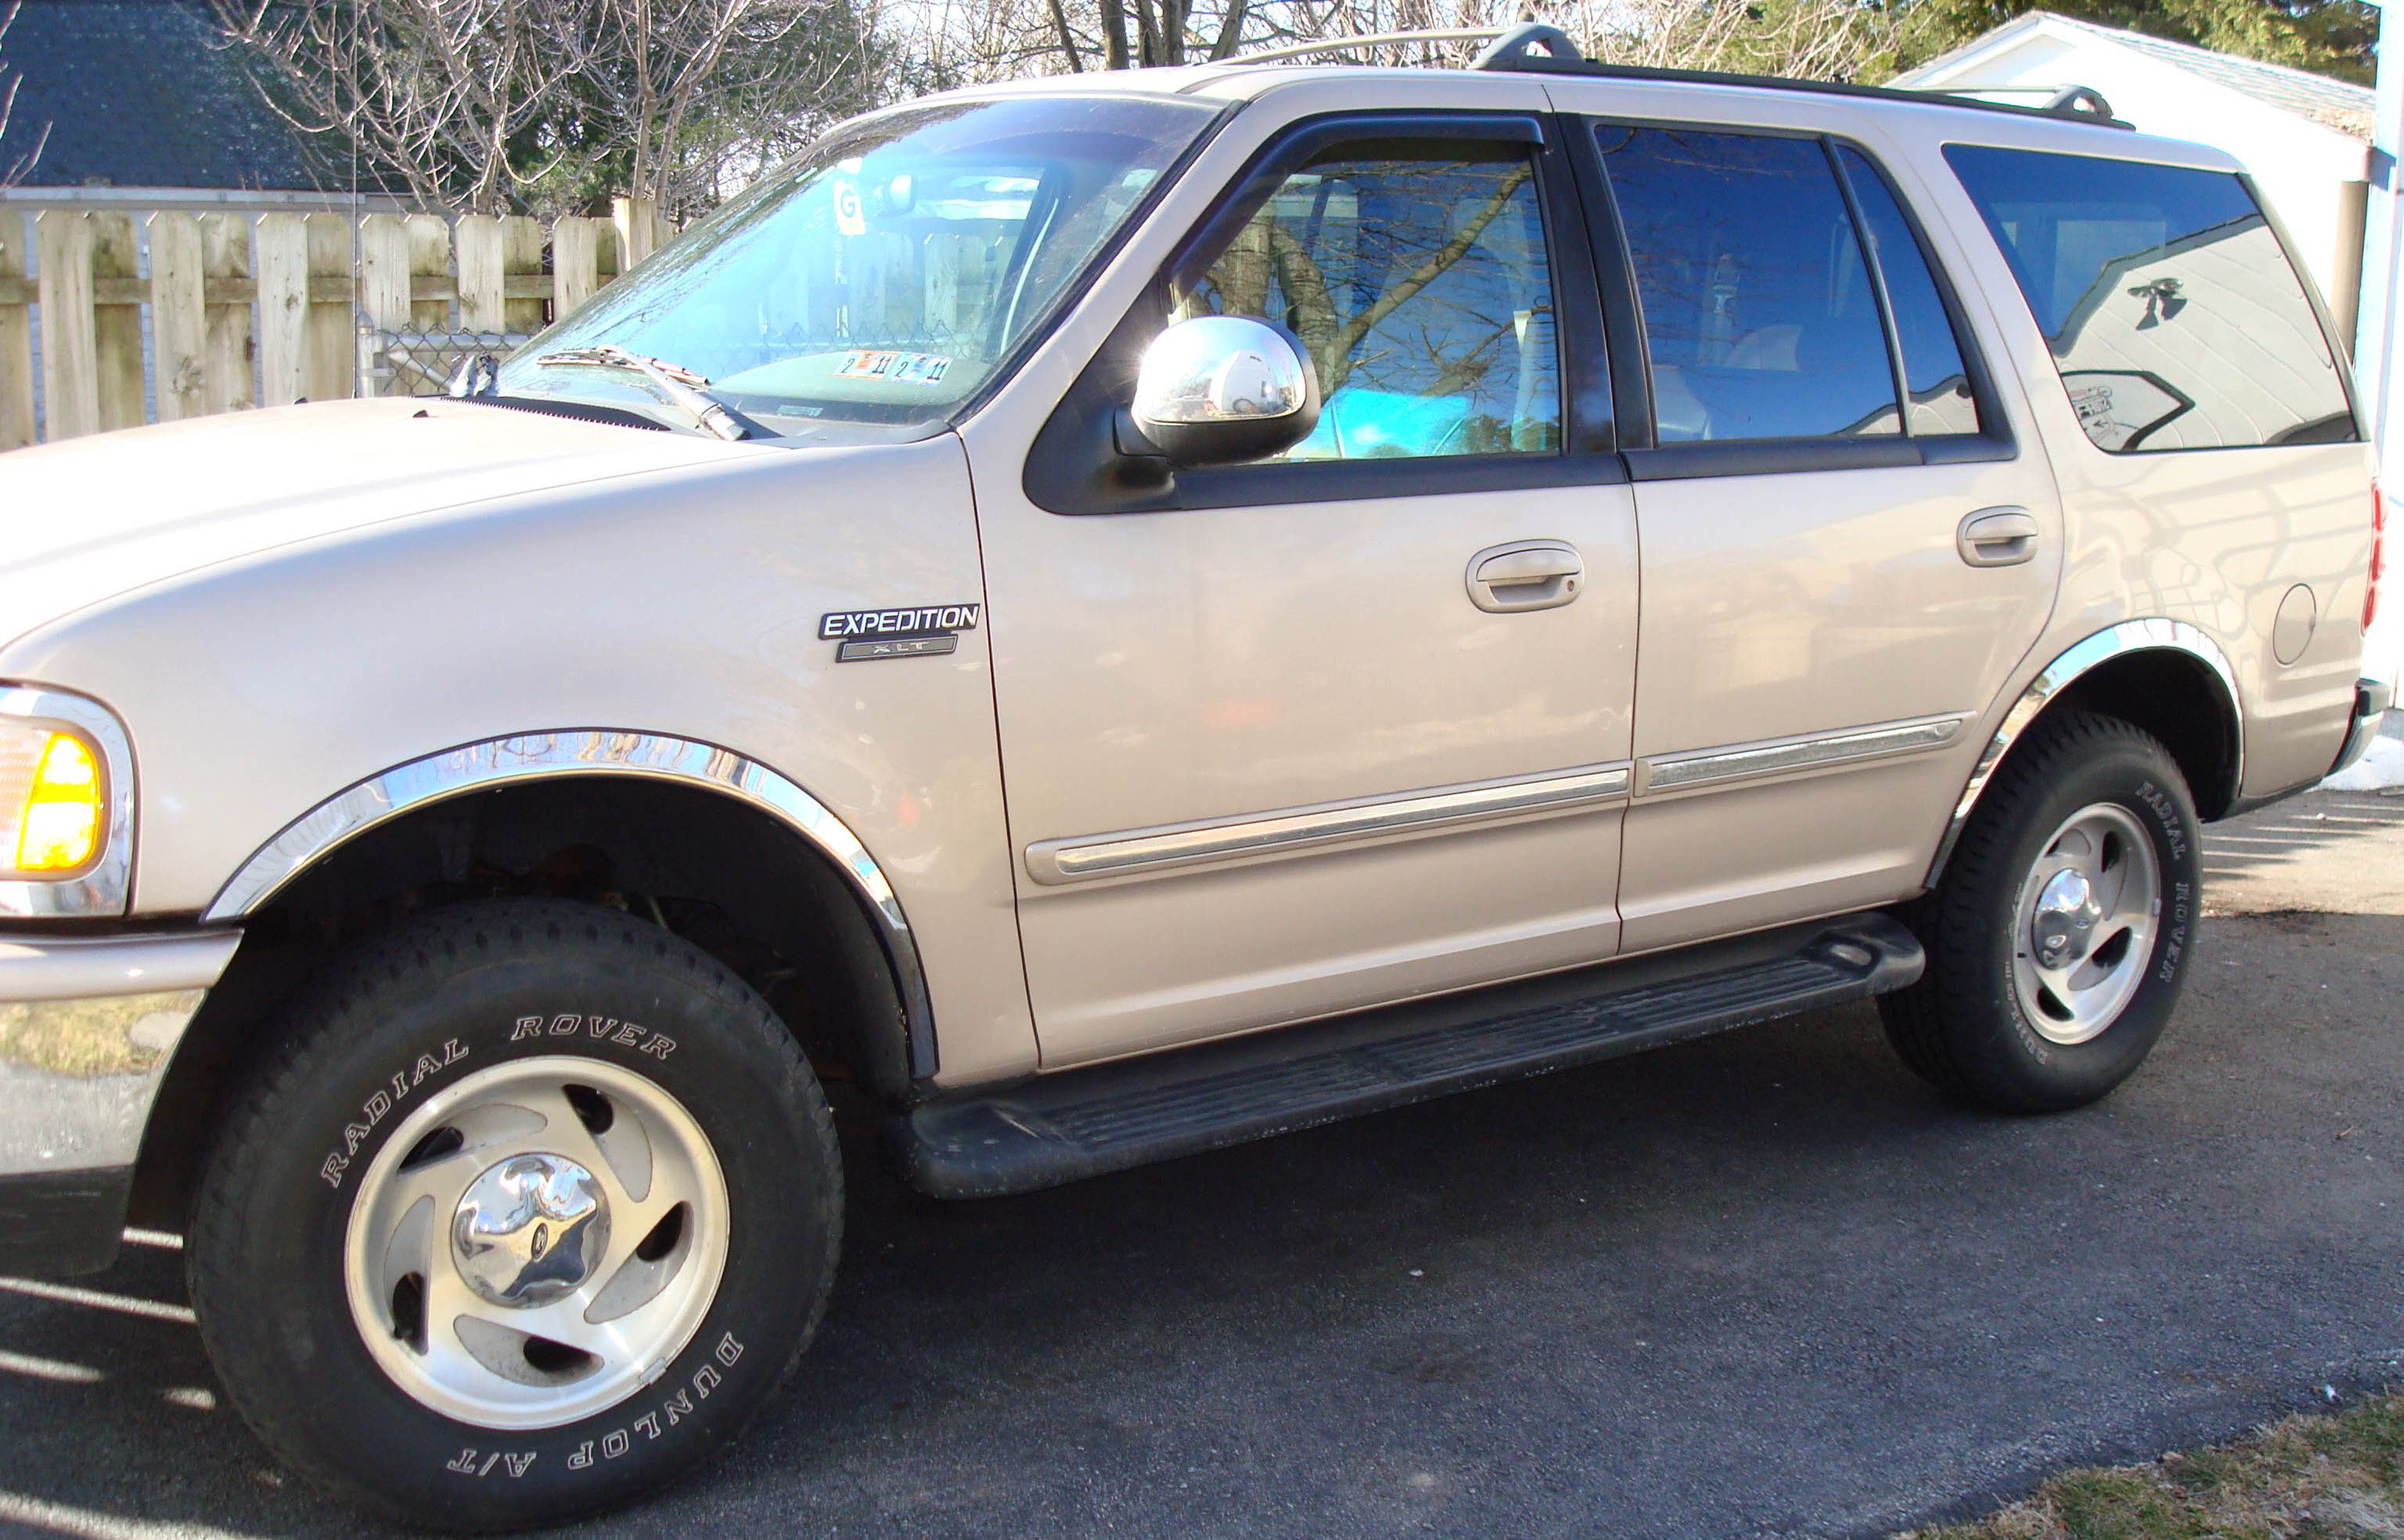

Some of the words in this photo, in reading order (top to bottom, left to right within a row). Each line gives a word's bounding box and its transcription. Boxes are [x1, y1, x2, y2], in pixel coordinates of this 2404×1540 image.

[840, 189, 856, 218] G
[840, 358, 855, 374] 2
[870, 354, 891, 374] 11
[894, 361, 909, 378] 2
[927, 362, 948, 380] 11
[823, 606, 979, 636] EXPEDITION
[873, 641, 930, 654] XLT
[2135, 780, 2186, 861] RADIAL
[2159, 882, 2190, 984] ROVER
[321, 1038, 470, 1189] RADIAL
[510, 1013, 678, 1060] ROVER
[567, 1331, 745, 1470] DUNLOP
[446, 1448, 538, 1478] A/T
